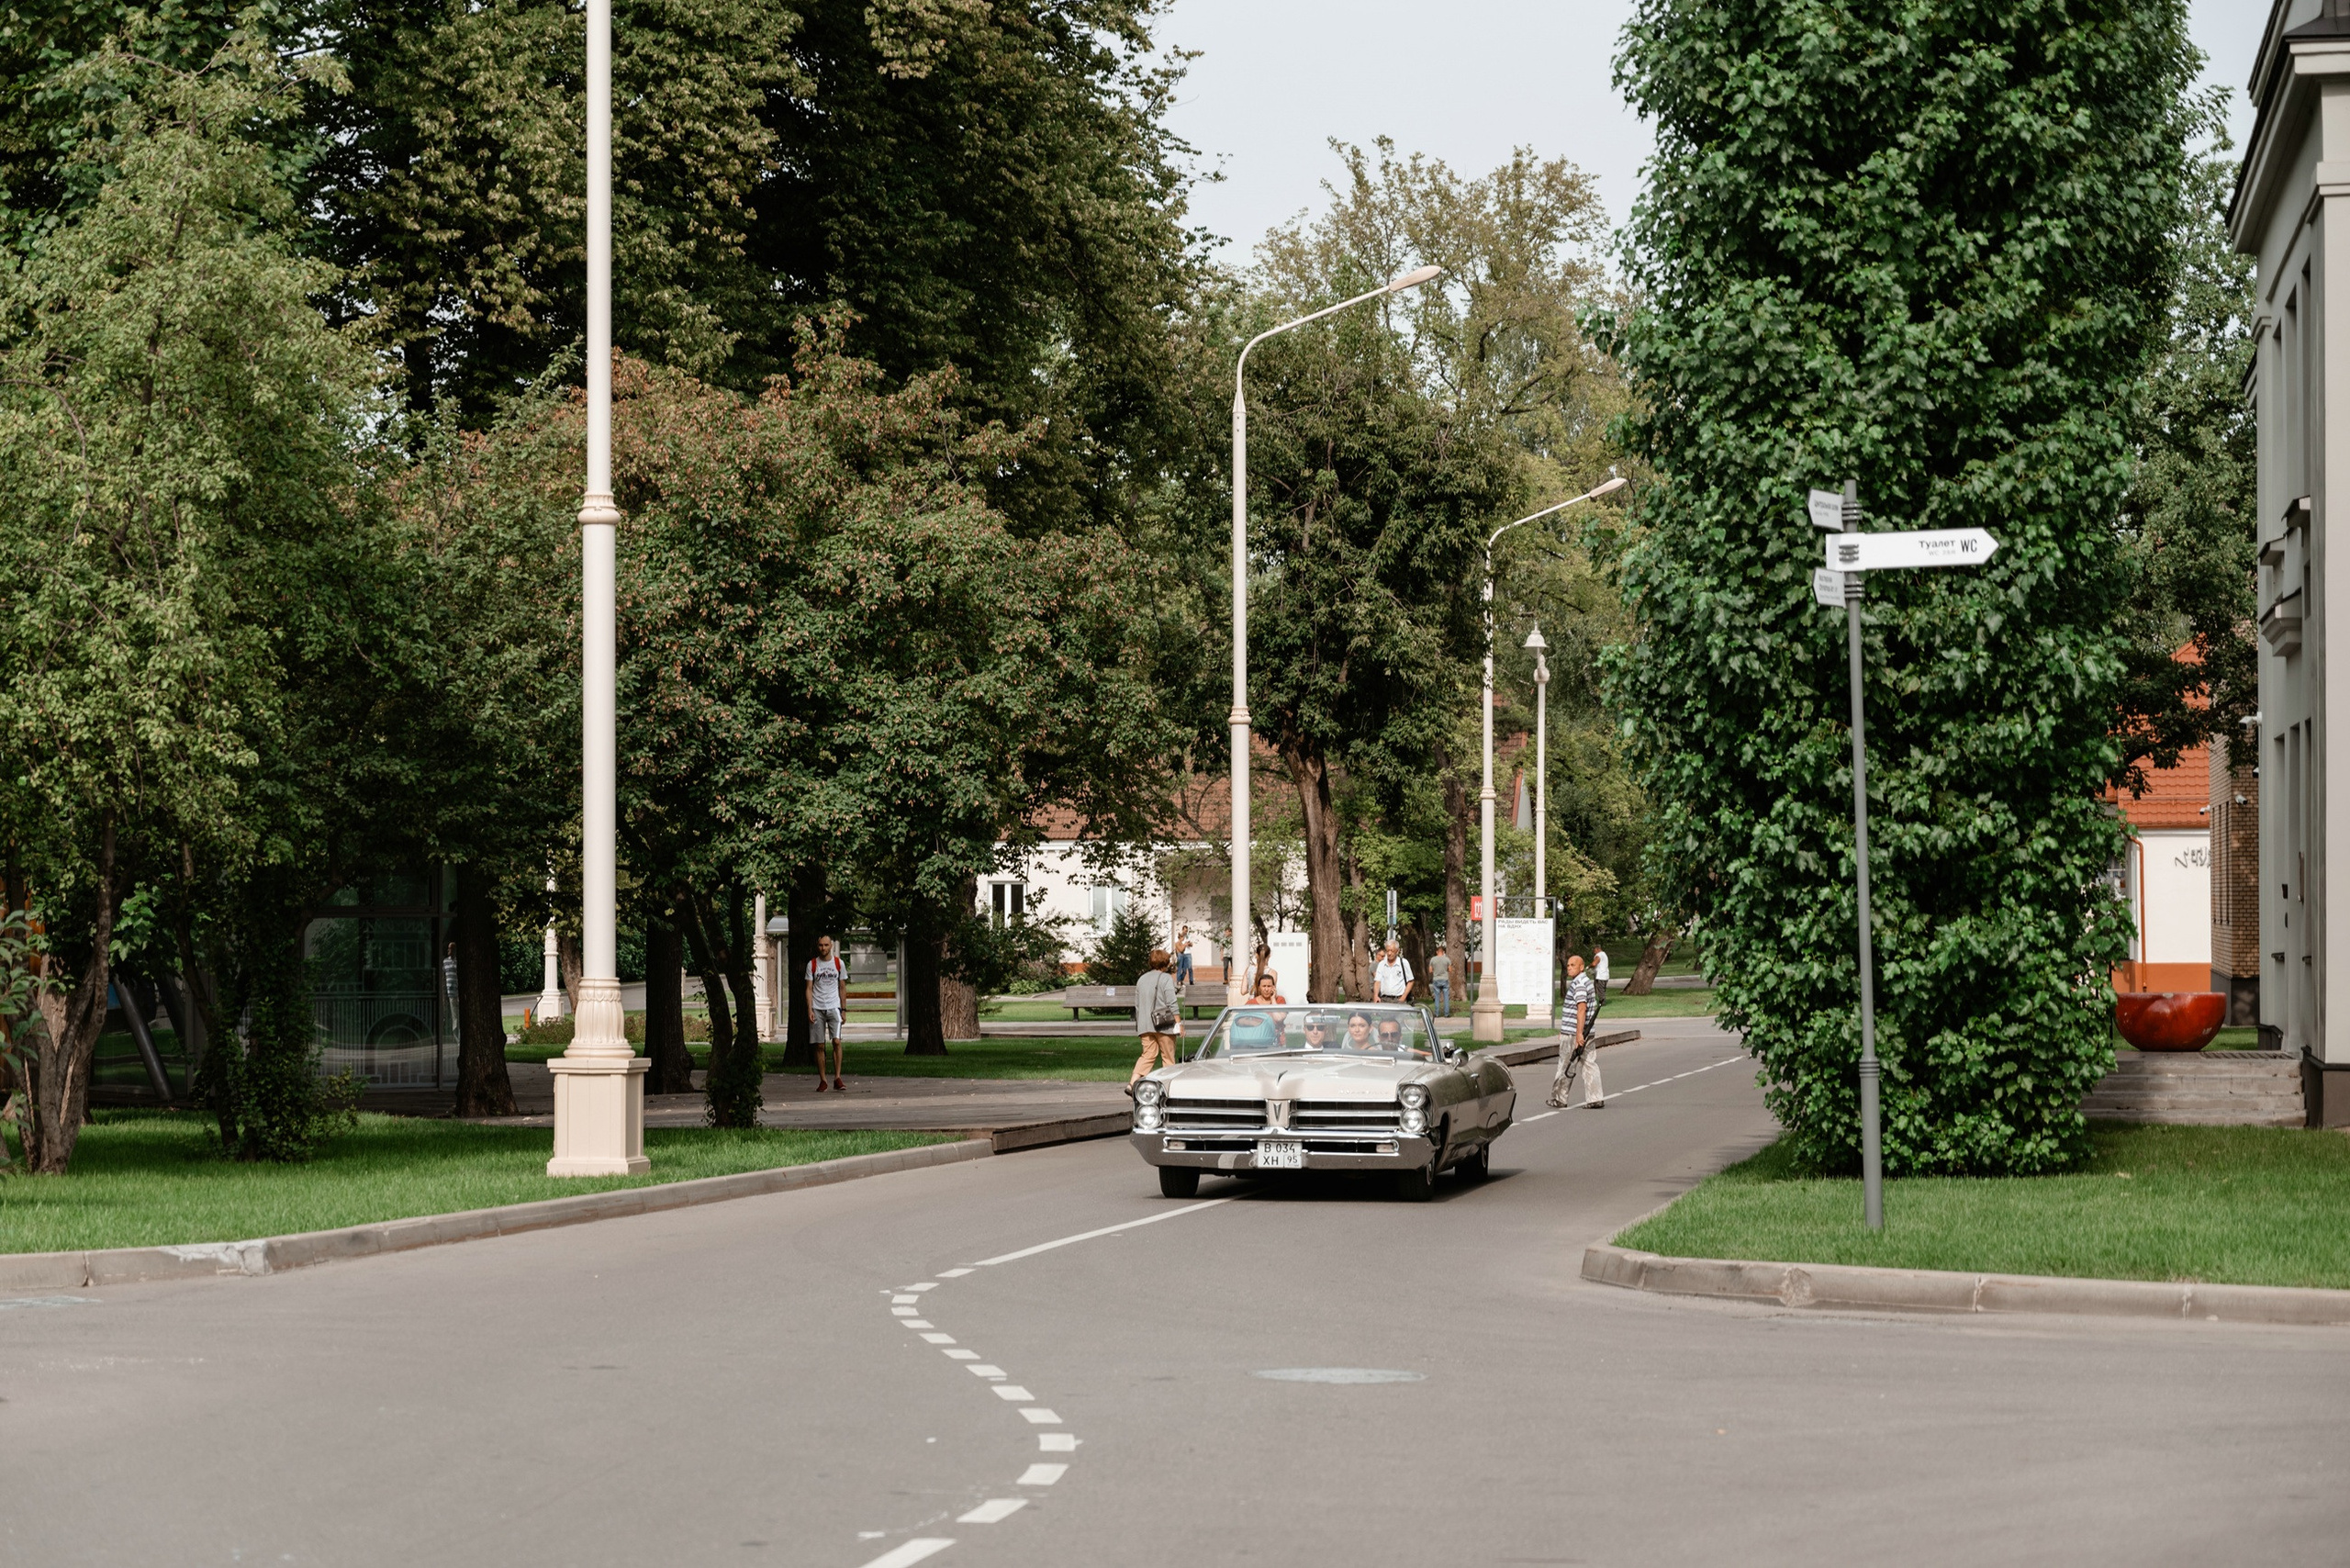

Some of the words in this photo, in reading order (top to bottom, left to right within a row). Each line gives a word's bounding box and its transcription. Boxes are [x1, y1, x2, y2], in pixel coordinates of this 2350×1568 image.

[1960, 538, 1977, 553] WC
[1275, 1143, 1295, 1153] 034
[1287, 1155, 1298, 1163] 95
